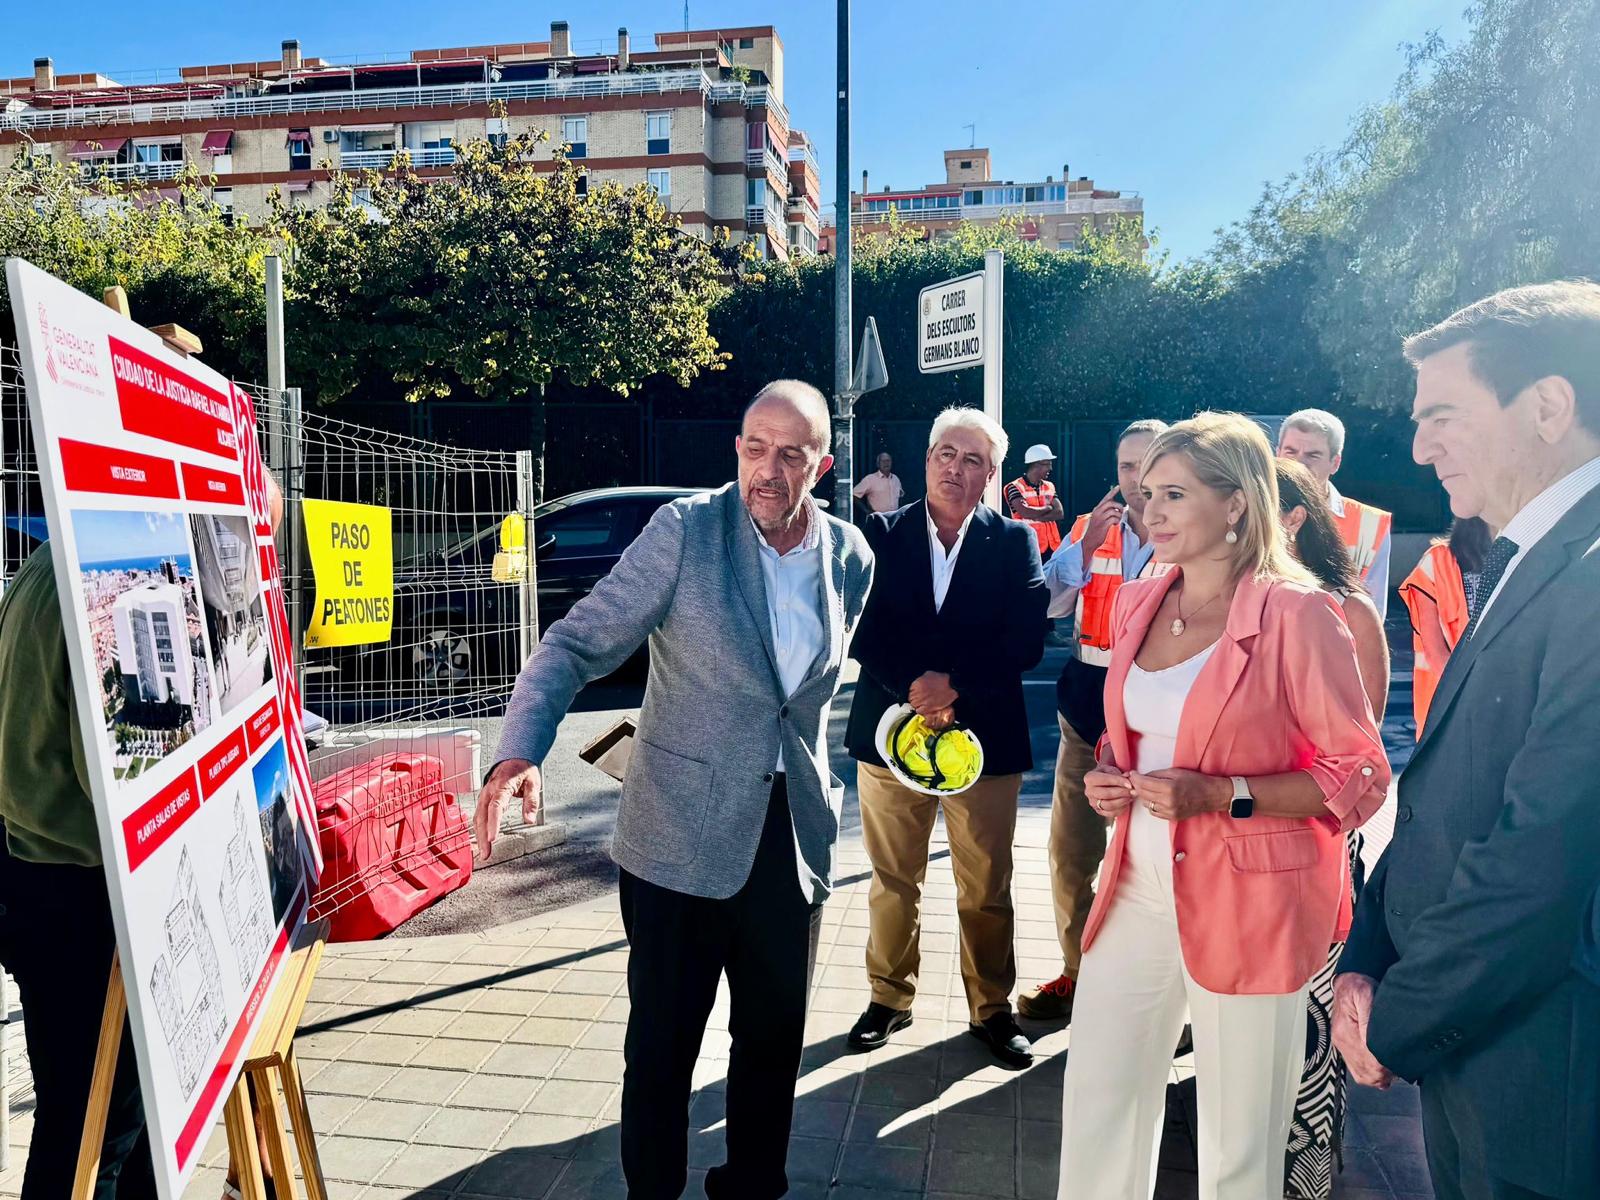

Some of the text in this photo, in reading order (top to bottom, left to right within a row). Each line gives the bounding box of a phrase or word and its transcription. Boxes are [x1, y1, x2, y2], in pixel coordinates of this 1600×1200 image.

[941, 289, 966, 311] CARRER
[927, 313, 976, 340] DELS ESCULTORS
[924, 336, 980, 363] GERMANS BLANCO
[113, 354, 145, 388] CIUDAD
[143, 366, 156, 393] DE
[153, 371, 166, 397] LA
[164, 377, 194, 408] JUSTICIA
[331, 522, 370, 550] PASO
[343, 561, 363, 587] DE
[321, 597, 390, 626] PEATONES
[137, 788, 191, 845] PLANTA SALAS DE VISTAS
